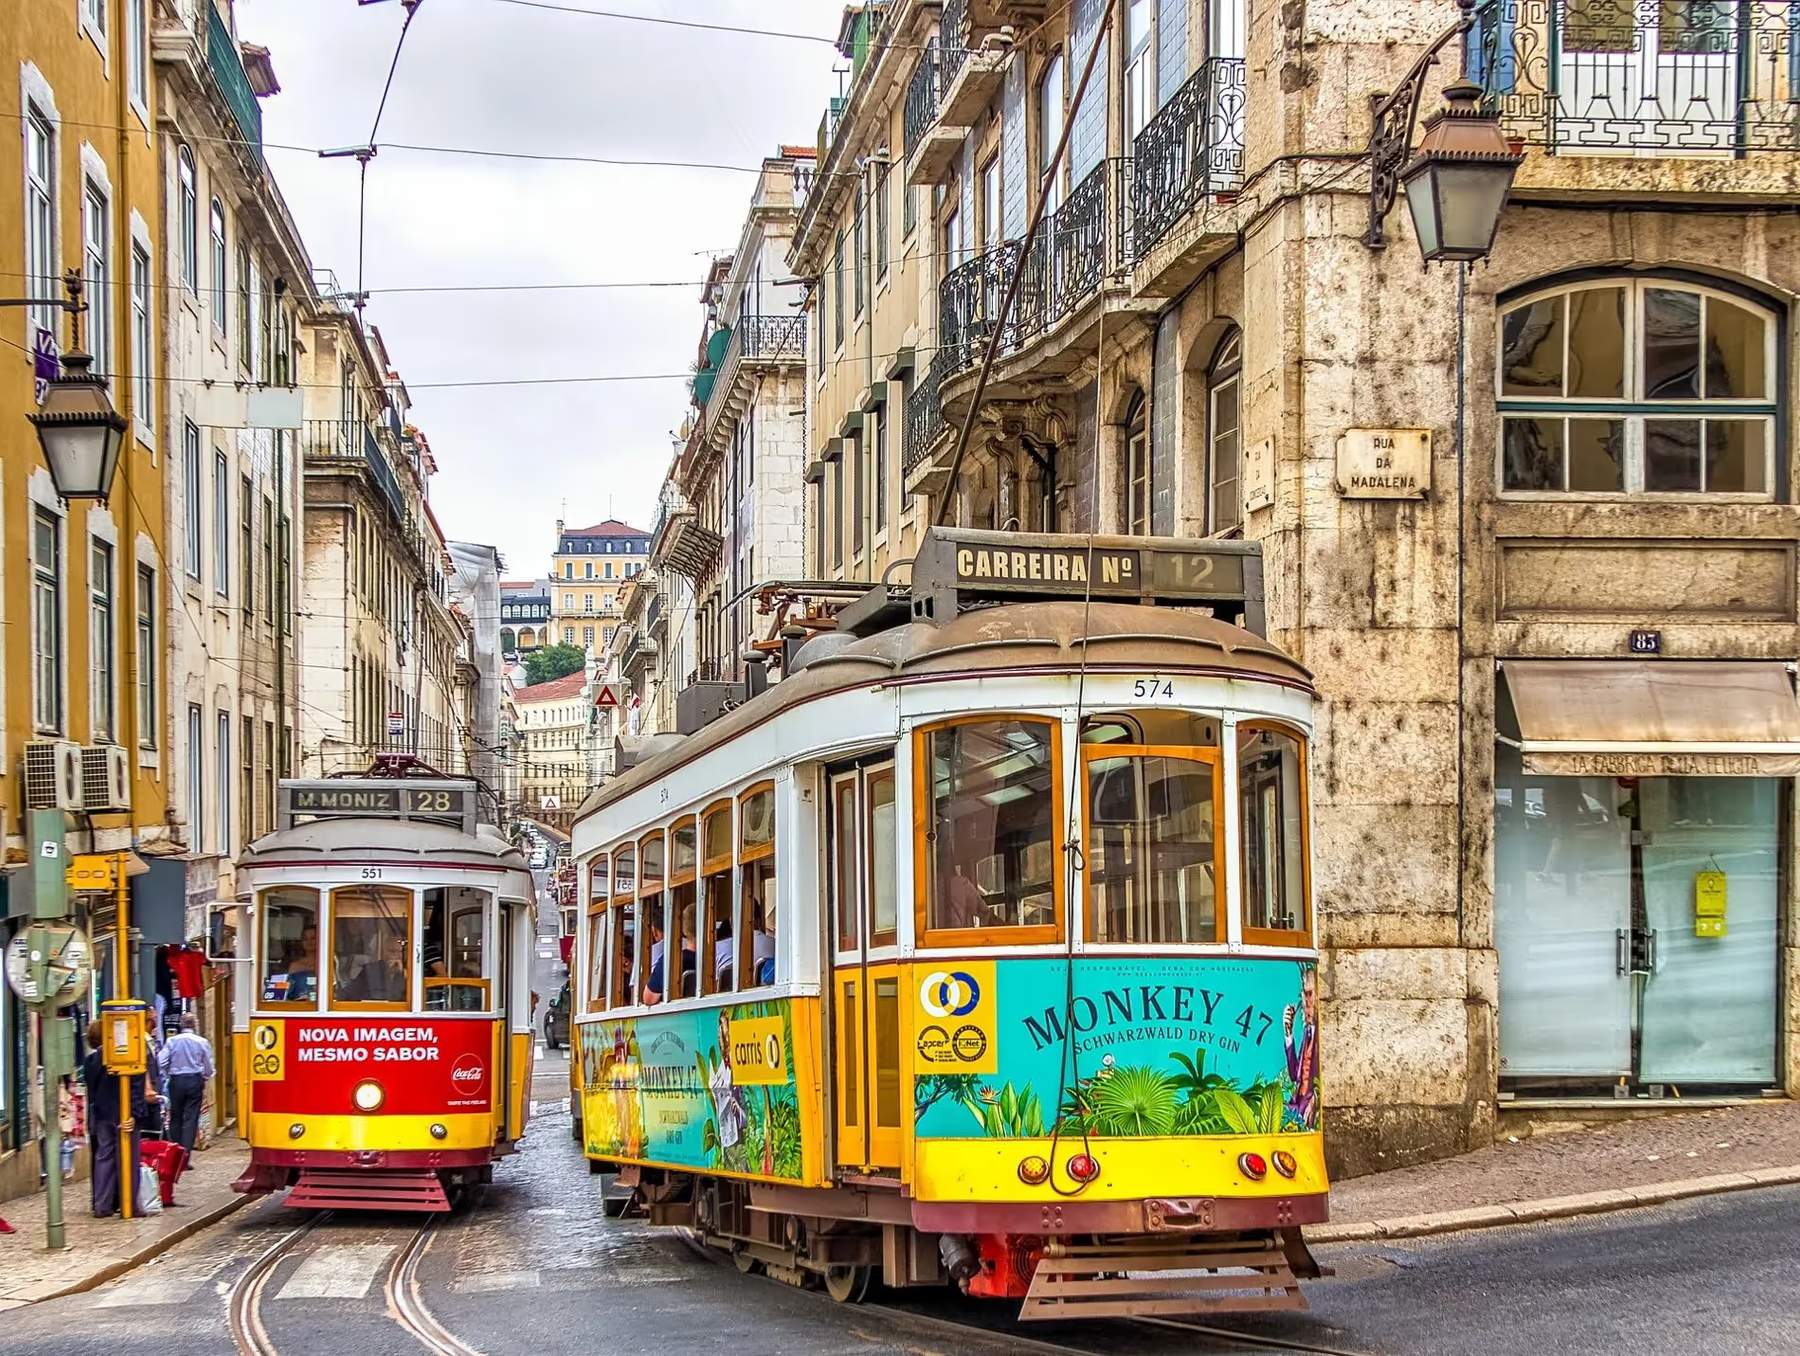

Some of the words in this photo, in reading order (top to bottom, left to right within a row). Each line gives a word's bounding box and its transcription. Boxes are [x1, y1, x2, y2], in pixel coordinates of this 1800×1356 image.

[1373, 438, 1395, 449] RUA
[1376, 457, 1392, 469] DA
[1351, 476, 1416, 489] MADALENA
[957, 549, 1088, 582] CARREIRA
[1101, 556, 1133, 584] Nº
[1170, 554, 1215, 589] 12
[1134, 679, 1174, 698] 574
[297, 792, 391, 808] M.MONIZ
[417, 791, 450, 812] 28
[361, 868, 383, 879] 551
[1021, 985, 1225, 1051] MONKEY
[1234, 1004, 1274, 1047] 47
[299, 1028, 350, 1043] NOVA
[354, 1028, 438, 1044] IMAGEM,
[1074, 1027, 1183, 1055] SCHWARZWALD
[1189, 1028, 1216, 1044] DRY
[1219, 1037, 1240, 1054] GIN
[298, 1048, 368, 1062] MESMO
[373, 1048, 439, 1061] SABOR
[735, 1032, 763, 1065] carris
[643, 1065, 685, 1099] MONKEY
